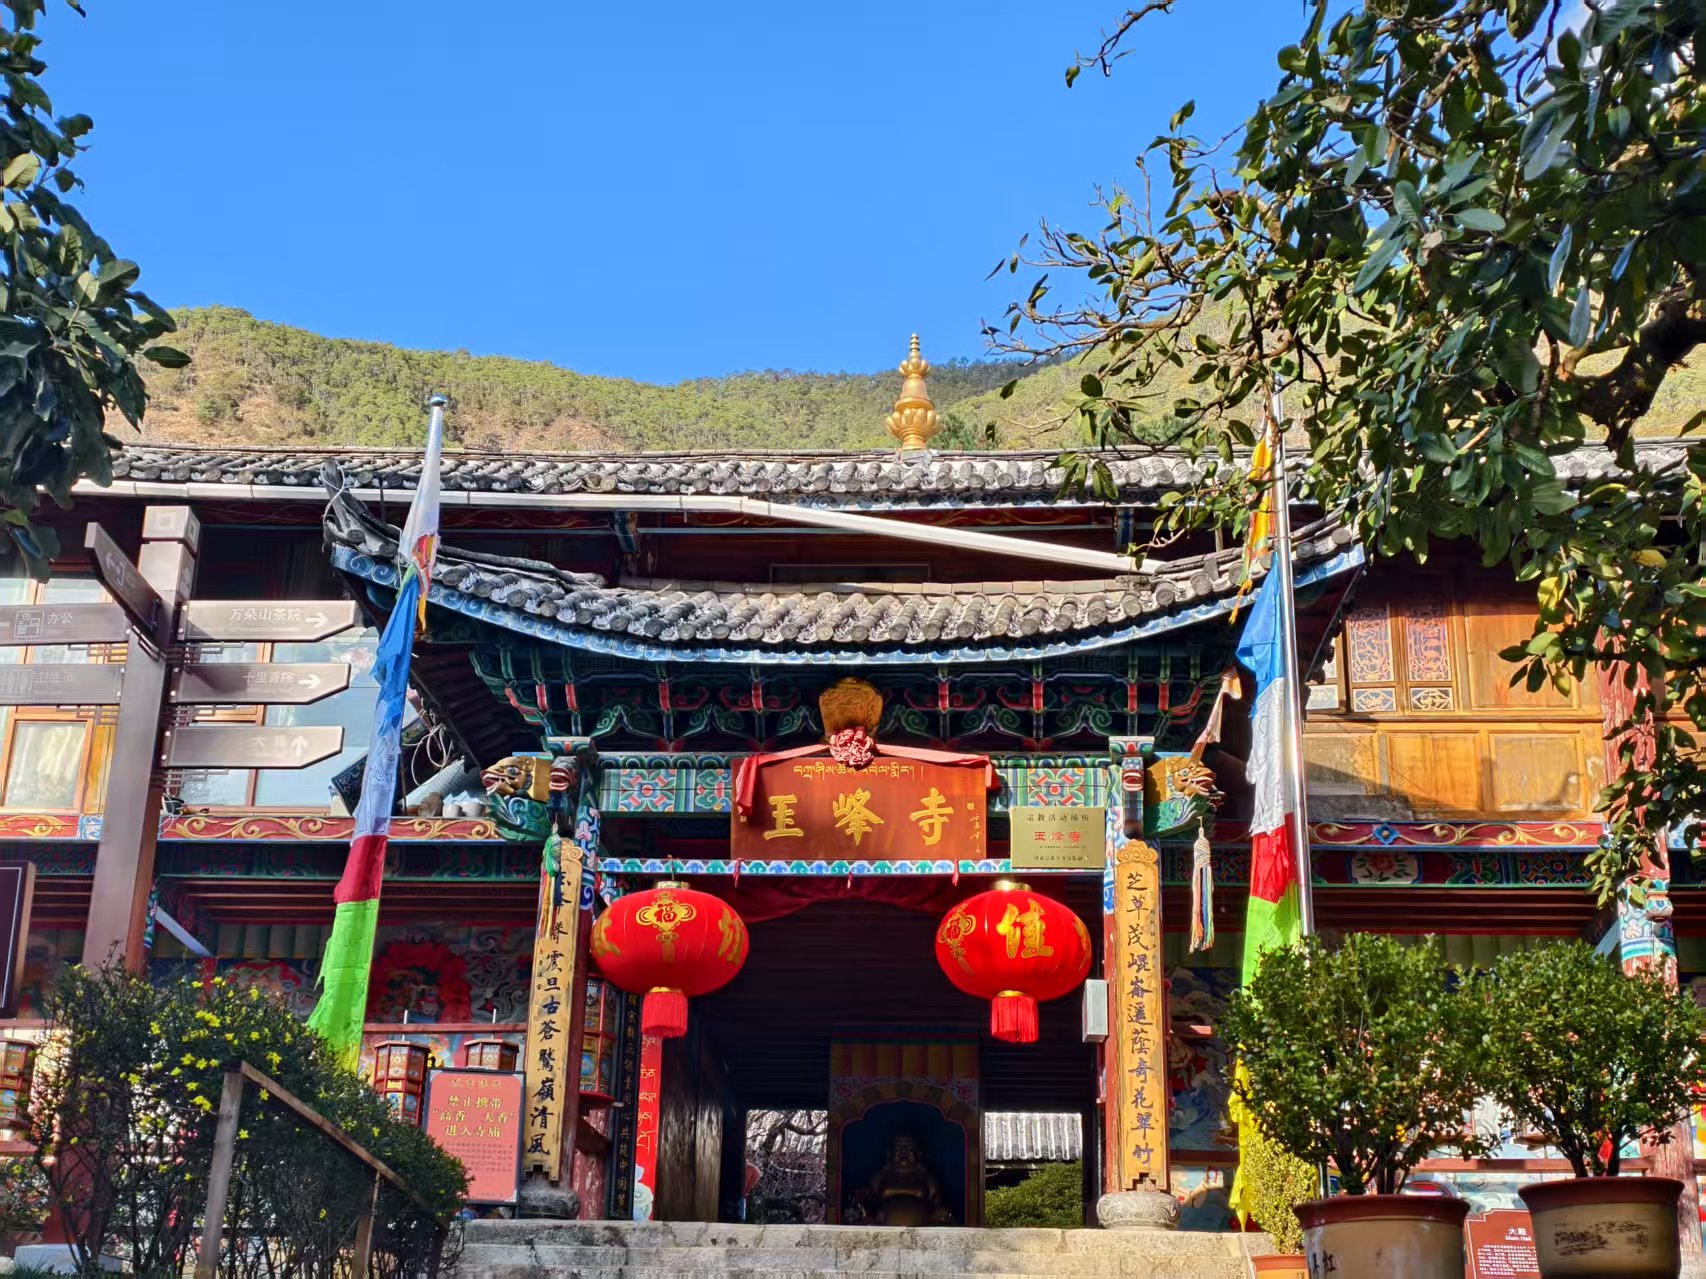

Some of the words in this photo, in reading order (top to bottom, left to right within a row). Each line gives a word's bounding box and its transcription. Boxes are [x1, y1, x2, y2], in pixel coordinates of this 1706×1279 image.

[47, 611, 73, 624] 办公
[653, 902, 678, 923] 福
[449, 1096, 503, 1109] 禁止携带
[445, 1125, 501, 1138] 进入寺庙
[1508, 1227, 1527, 1236] 大殿
